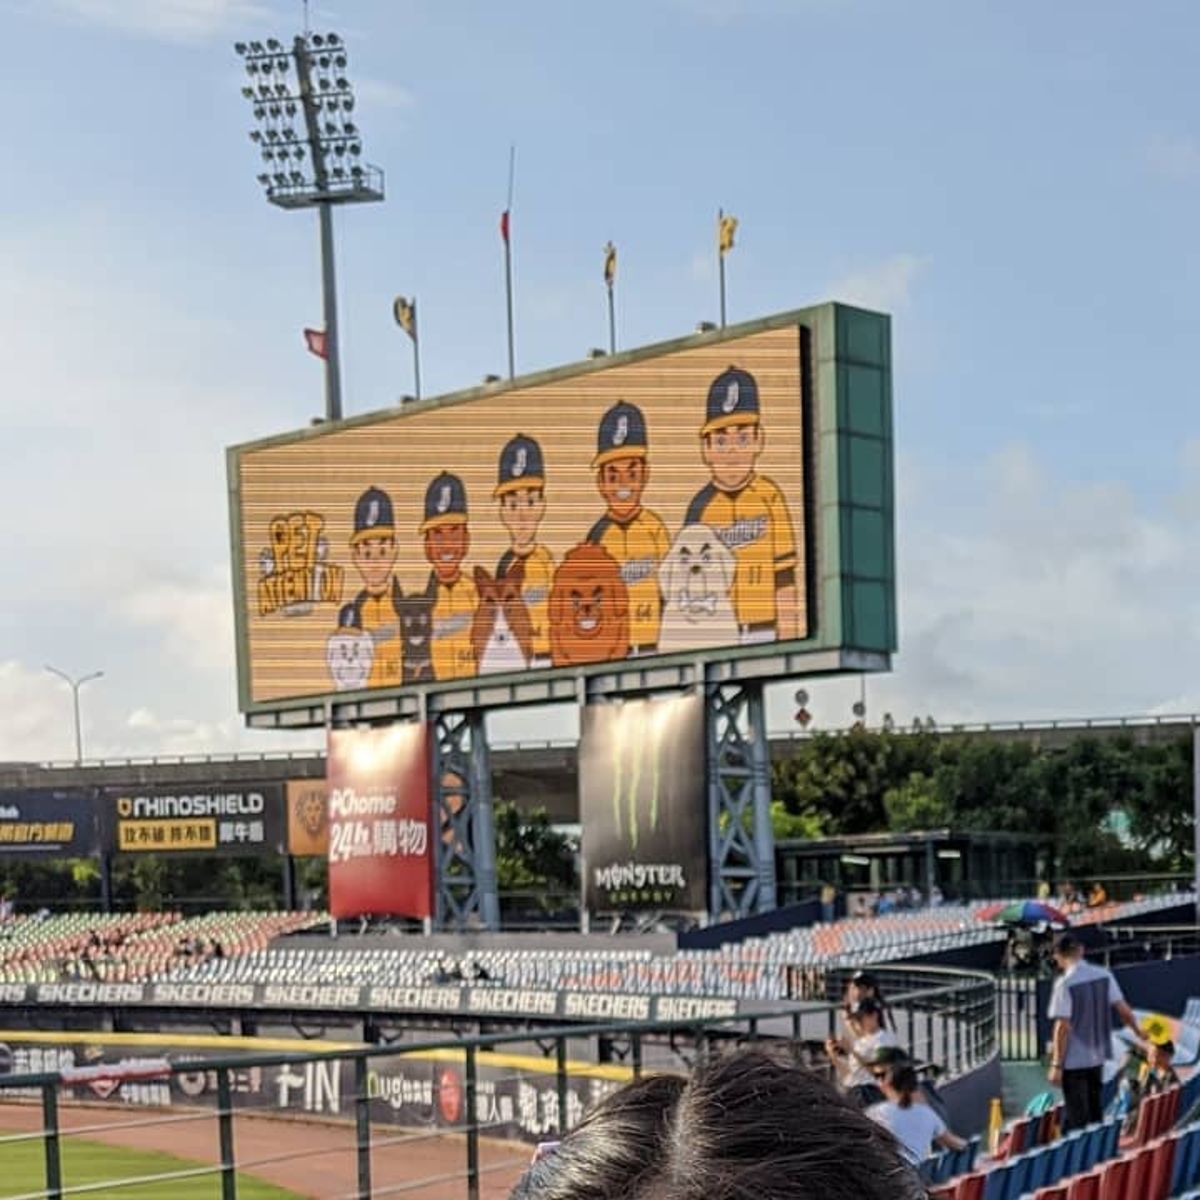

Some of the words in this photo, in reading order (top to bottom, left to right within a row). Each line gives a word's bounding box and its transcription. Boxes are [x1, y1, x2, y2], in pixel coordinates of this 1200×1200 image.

[133, 793, 264, 816] RHINOSHIELD
[329, 788, 396, 818] PChome
[595, 861, 686, 890] MONSTER
[37, 984, 144, 1002] SKECHERS
[154, 984, 254, 1002] SKECHERS
[265, 986, 360, 1004] SKECHERS
[370, 985, 461, 1009] SKECHERS
[469, 989, 556, 1014] SKECHERS
[565, 993, 649, 1019] SKECHERS
